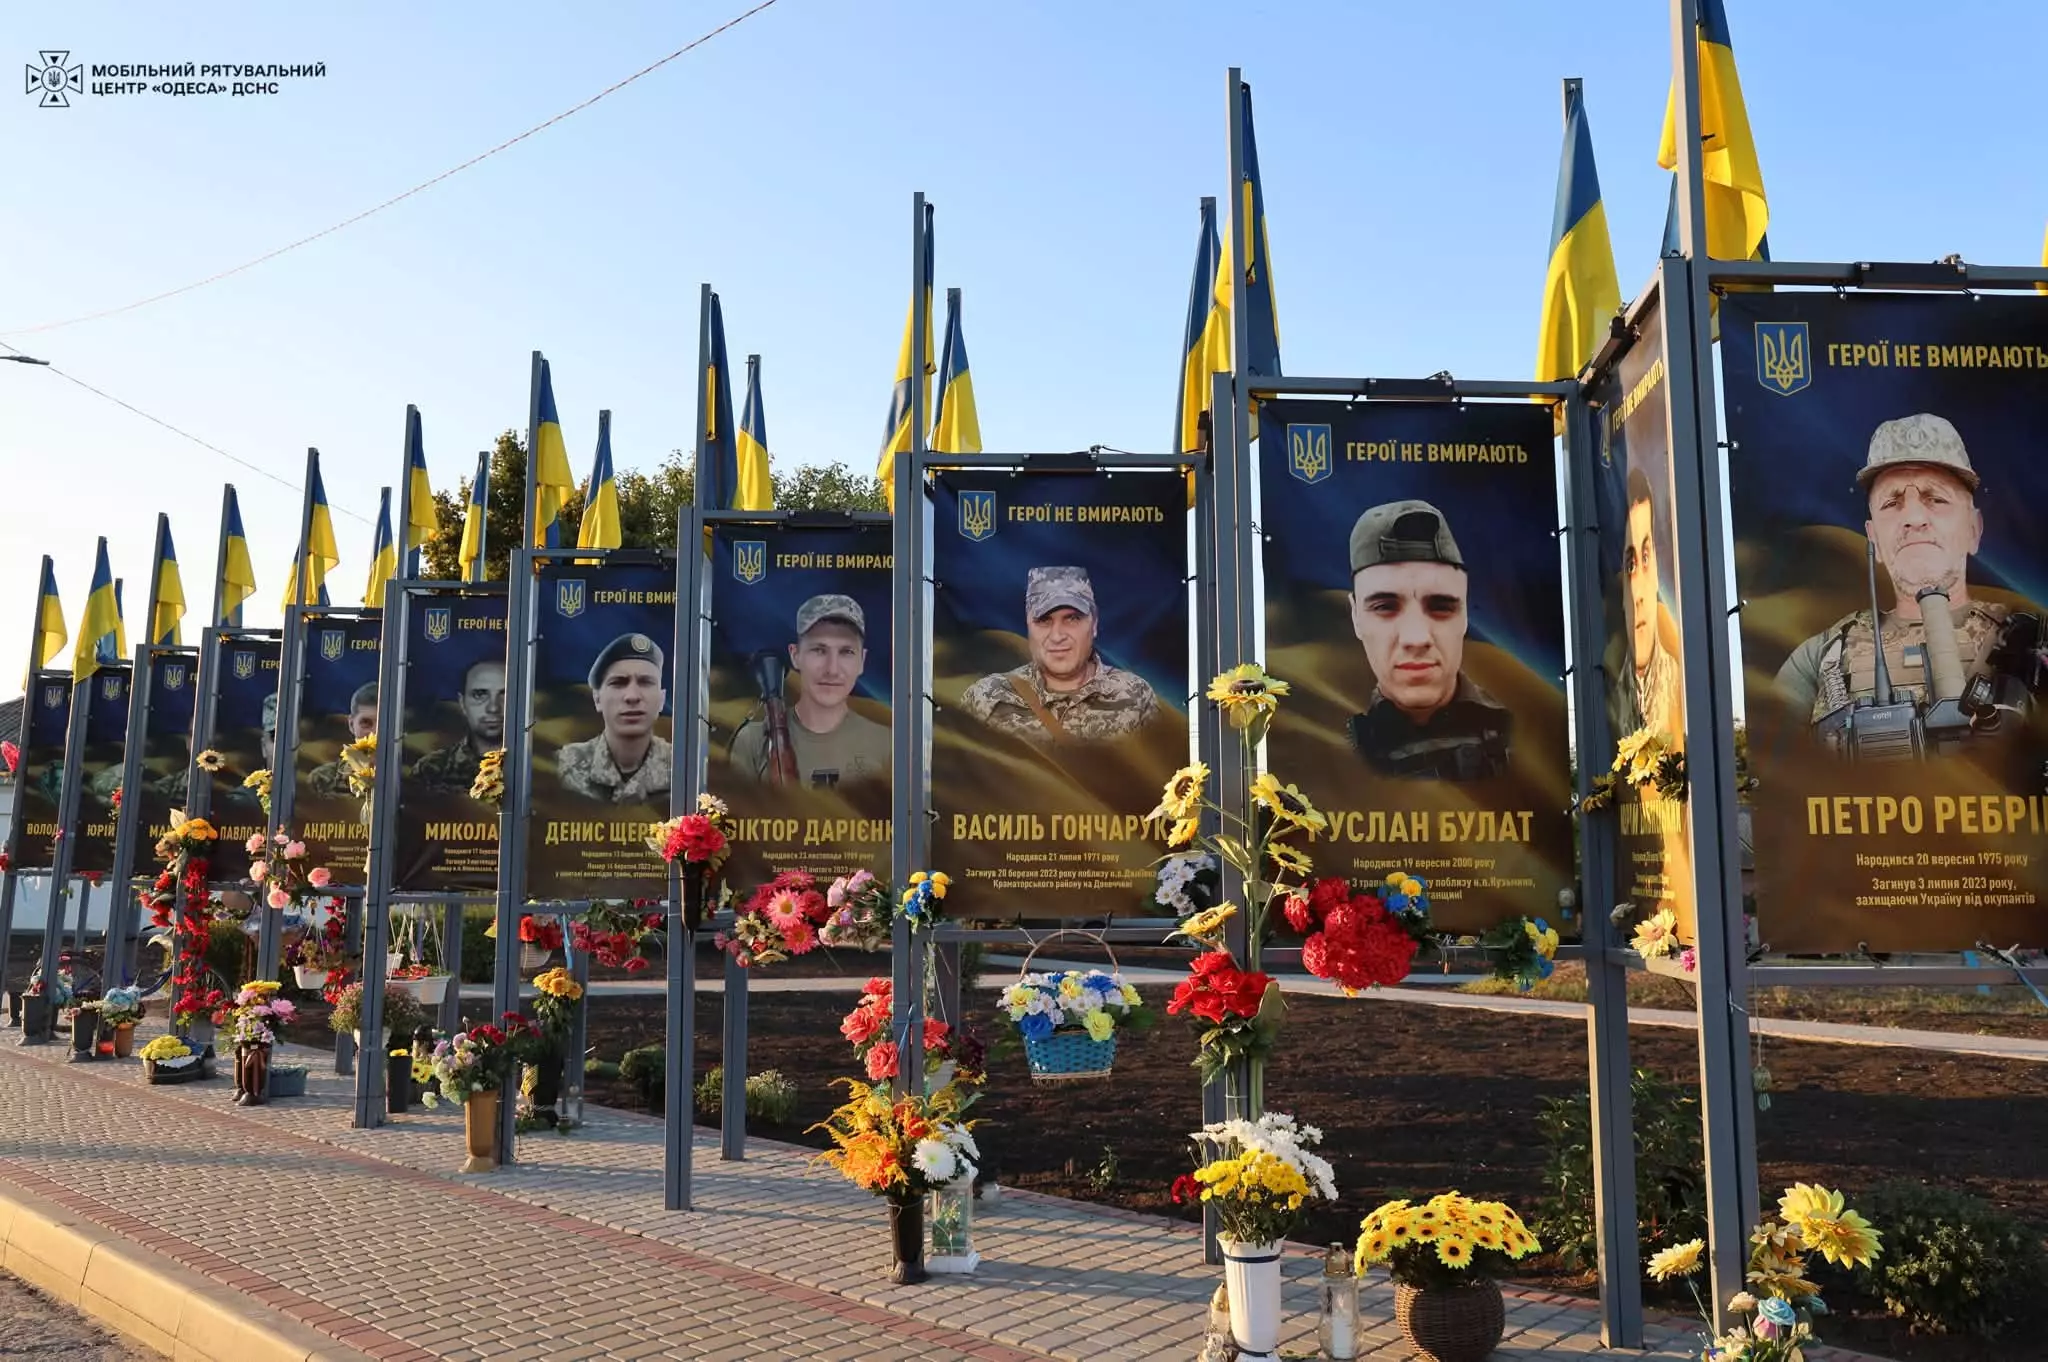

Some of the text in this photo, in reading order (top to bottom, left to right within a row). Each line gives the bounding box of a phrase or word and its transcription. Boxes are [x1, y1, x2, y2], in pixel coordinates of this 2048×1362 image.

[1828, 340, 2048, 368] ГЕРОЇ НЕ ВМИРАЮТЬ
[1346, 440, 1528, 463] ГЕРОЇ НЕ ВМИРАЮТЬ
[1008, 503, 1164, 522] ГЕРОЇ НЕ ВМИРАЮТЬ
[777, 551, 814, 568] ГЕРОЇ
[817, 555, 832, 568] НЕ
[594, 589, 627, 603] ГЕРОЇ
[629, 591, 643, 603] НЕ
[458, 616, 502, 630] ГЕРОЇ НЕ
[1807, 796, 1923, 835] ПЕТРО
[303, 821, 345, 842] АНДРІЙ
[425, 823, 498, 840] МИКОЛА
[545, 822, 649, 845] ДЕНИС ЩЕР
[953, 814, 1169, 841] ВАСИЛЬ ГОНЧАРУК
[1439, 811, 1534, 842] БУЛАТ
[1006, 852, 1047, 864] Народився
[1353, 857, 1401, 871] Народився
[1404, 857, 1413, 868] 19
[1415, 859, 1450, 871] вересня
[1474, 859, 1495, 870] року
[1856, 853, 2028, 868] Народився 20 вересня 1975 року
[965, 868, 997, 879] Загинув
[1359, 879, 1385, 889] травн
[1436, 877, 1472, 890] поблизу
[1872, 877, 2017, 892] Загинув 3 липня 2023 року,
[1856, 893, 2035, 908] захищаючи Україну від окупантів
